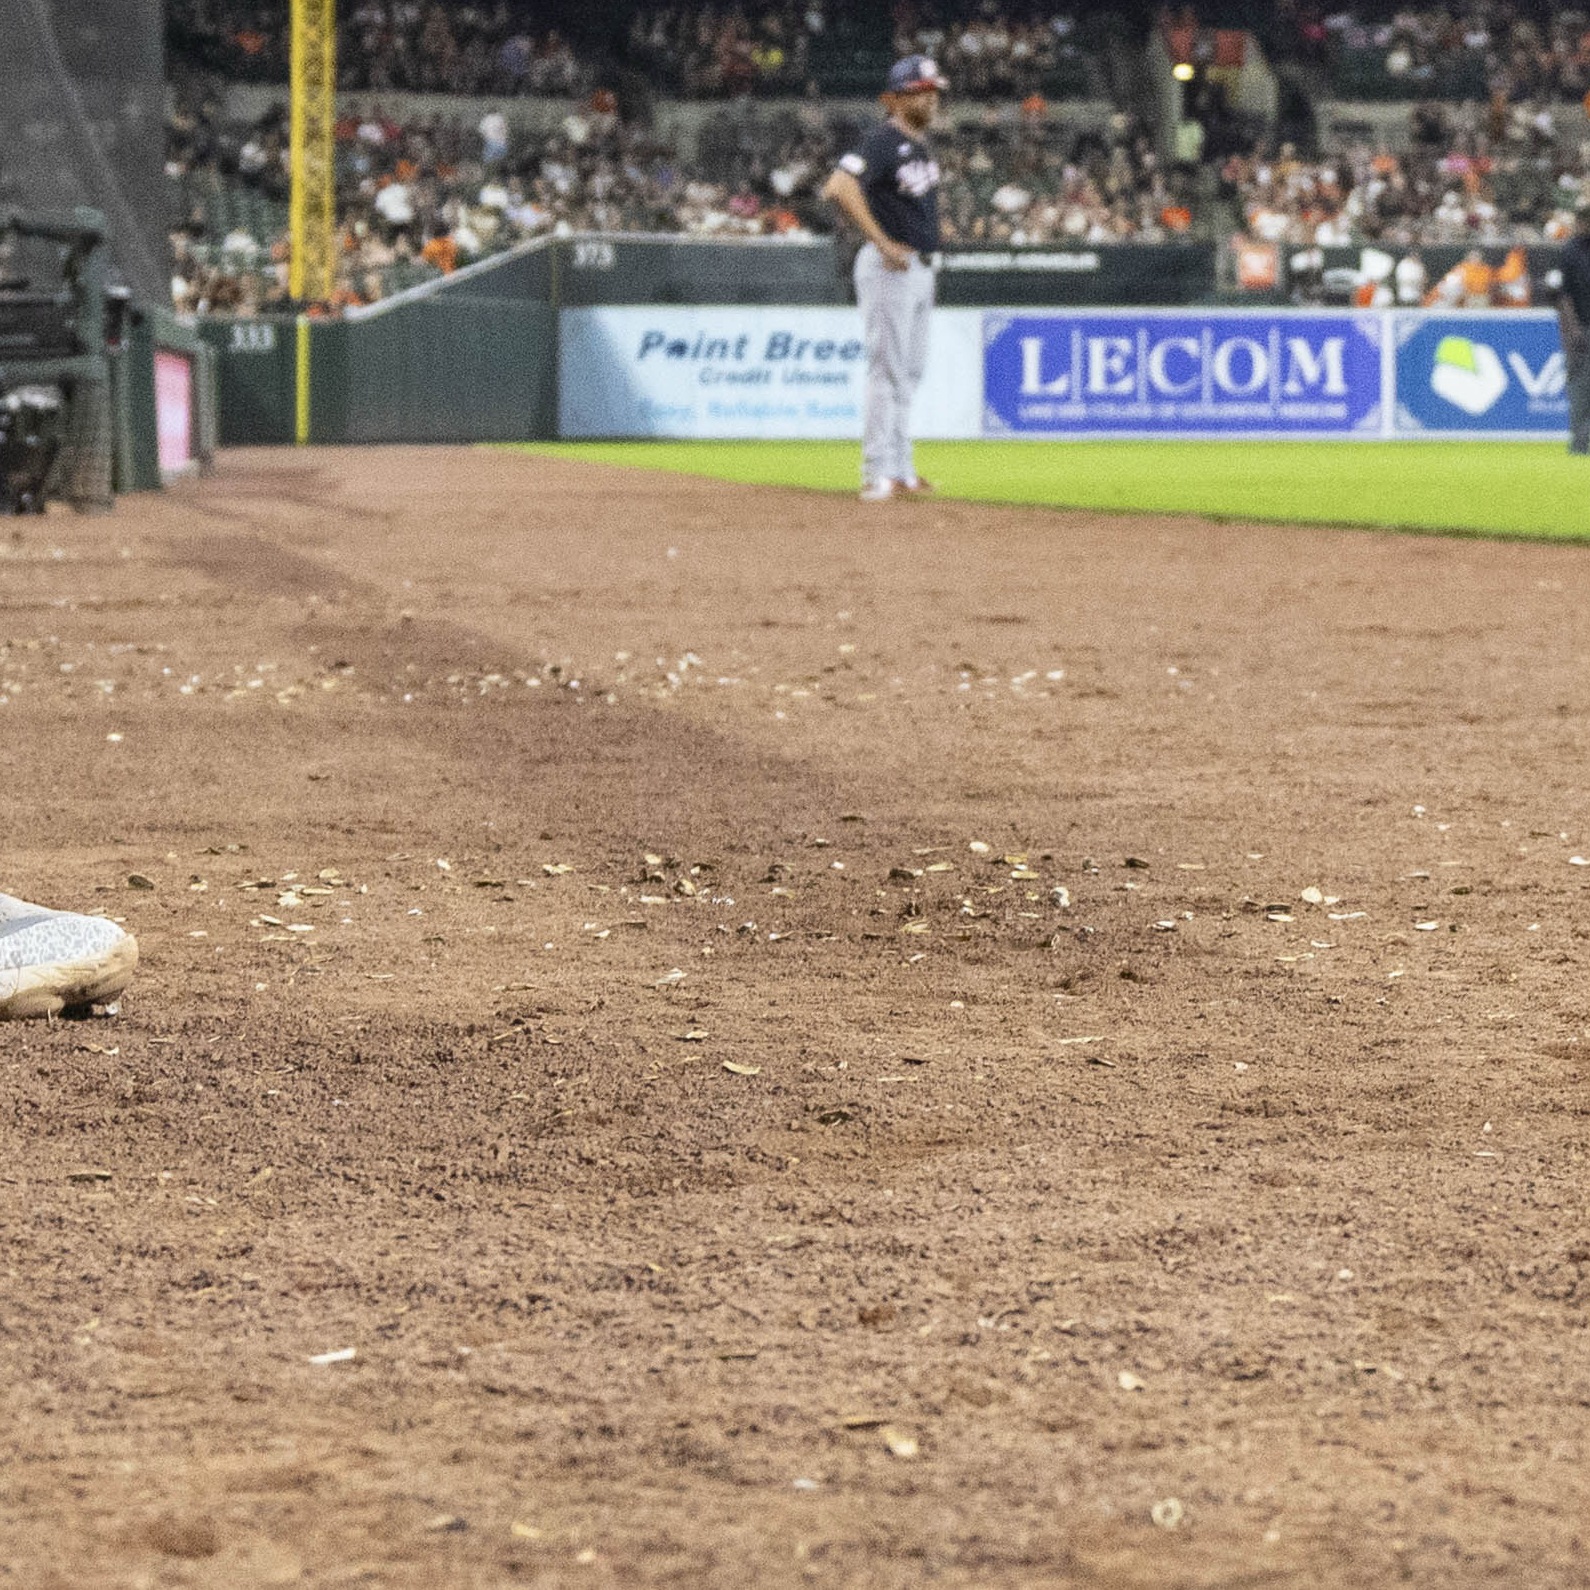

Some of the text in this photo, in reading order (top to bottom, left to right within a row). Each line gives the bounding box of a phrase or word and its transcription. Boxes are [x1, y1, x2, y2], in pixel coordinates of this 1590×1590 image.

[637, 328, 867, 362] Point Bree
[1018, 335, 1349, 397] LECOM
